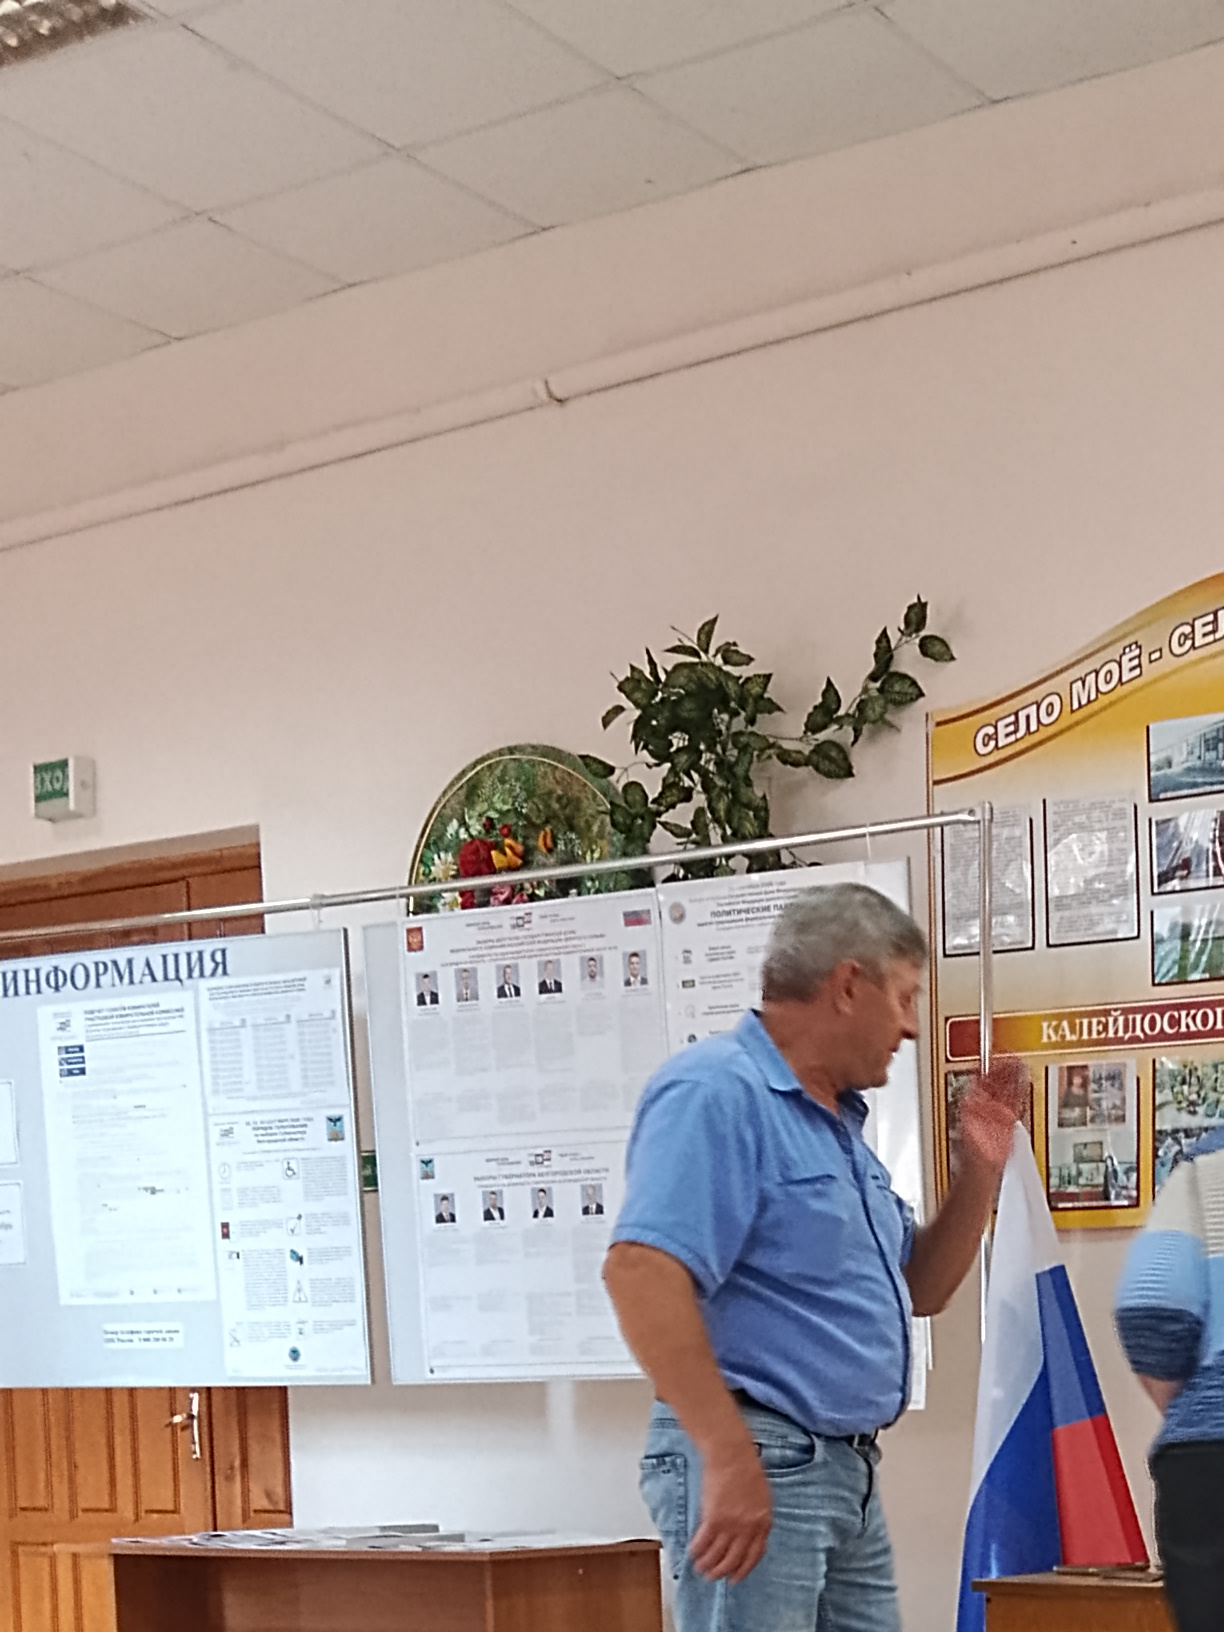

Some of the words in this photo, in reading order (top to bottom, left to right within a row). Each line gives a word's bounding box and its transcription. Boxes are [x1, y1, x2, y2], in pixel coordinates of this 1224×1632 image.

[973, 692, 1064, 757] СЕЛО
[1070, 641, 1142, 716] МОЁ
[1, 948, 229, 998] ИНФОРМАЦИЯ
